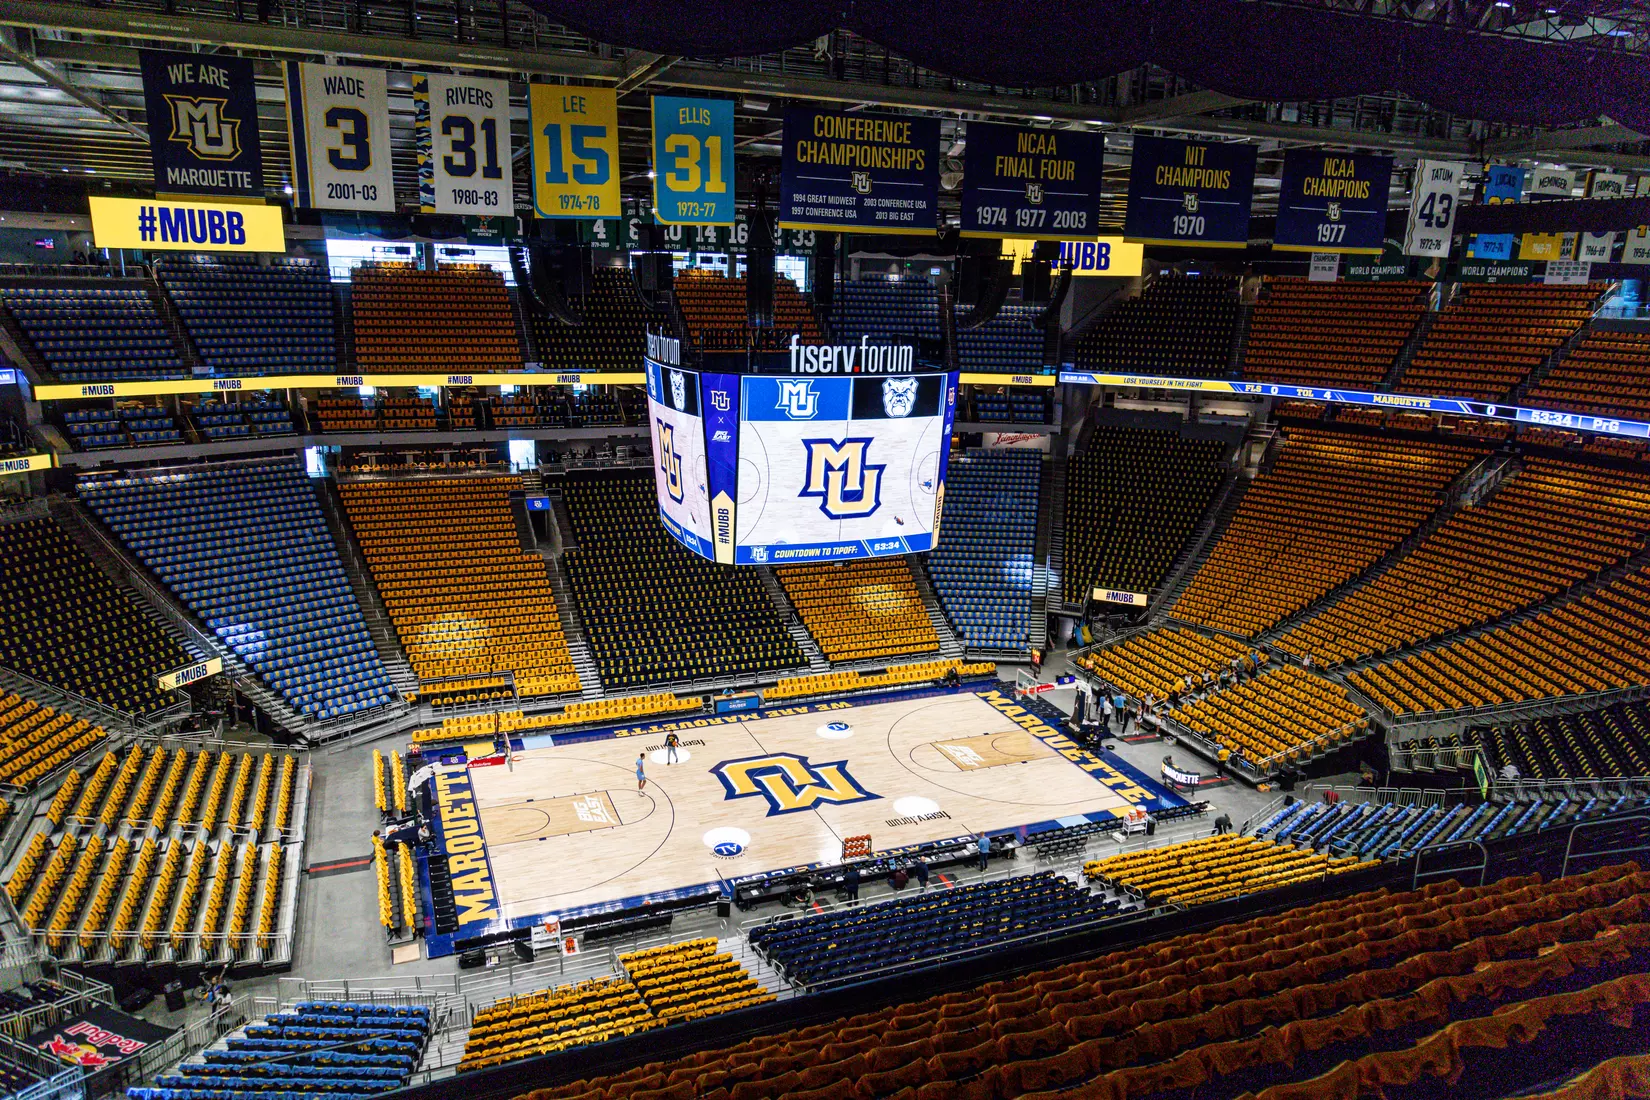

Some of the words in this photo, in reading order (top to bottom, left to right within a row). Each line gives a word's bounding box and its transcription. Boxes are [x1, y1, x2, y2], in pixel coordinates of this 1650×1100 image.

[168, 63, 195, 85] WE
[198, 65, 230, 90] ARE
[324, 76, 365, 99] WADE
[446, 87, 493, 109] RIVERS
[563, 96, 586, 115] LEE
[679, 107, 711, 126] ELLIS
[163, 94, 241, 161] MU
[814, 115, 912, 144] CONFERENCE
[324, 106, 372, 172] 3
[441, 114, 503, 180] 31
[1017, 132, 1057, 156] NCAA
[543, 123, 610, 185] 15
[665, 134, 726, 193] 31
[797, 140, 925, 171] CHAMPIONSHIPS
[1185, 146, 1207, 166] NIT
[167, 167, 252, 189] MARQUETTE
[995, 156, 1036, 178] FINAL
[1040, 159, 1075, 181] FOUR
[1156, 166, 1231, 189] CHAMPIONS
[1323, 158, 1355, 178] NCAA
[1432, 168, 1453, 184] TATUM
[851, 171, 872, 194] MU
[1303, 177, 1370, 199] CHAMPIONS
[1495, 174, 1516, 188] LUCAS
[1595, 180, 1622, 194] THOMPSON
[327, 182, 377, 201] 2001-03
[452, 188, 498, 206] 1980-83
[793, 193, 806, 202] 1994
[807, 194, 826, 204] GREAT
[828, 196, 856, 206] MIDWEST
[1025, 183, 1044, 204] MU
[559, 194, 600, 210] 1974-78
[677, 201, 716, 218] 1973-77
[864, 198, 876, 206] 2003
[878, 198, 914, 208] CONFERENCE
[915, 200, 927, 209] USA
[1183, 192, 1198, 213] MU
[1326, 202, 1342, 222] MU
[1418, 192, 1453, 229] 43
[792, 206, 804, 216] 1997
[805, 207, 844, 218] CONFERENCE
[844, 210, 857, 219] USA
[876, 212, 888, 220] 2013
[889, 212, 899, 220] BIG
[900, 212, 915, 221] EAST
[976, 206, 1007, 226] 1974
[1016, 208, 1046, 228] 1977
[1053, 210, 1087, 228] 2003
[138, 206, 246, 245] #MUBB
[593, 219, 606, 239] 4
[728, 224, 748, 244] 16
[1172, 215, 1205, 236] 1970
[1317, 223, 1346, 243] 1977
[1420, 238, 1442, 250] 1972-76
[1350, 266, 1370, 275] WORLD
[1370, 266, 1405, 275] CHAMPIONS
[1462, 266, 1485, 276] WORLD
[1486, 266, 1529, 276] CHAMPIONS
[213, 379, 242, 390] #MUBB
[336, 376, 364, 386] #MUBB
[448, 375, 473, 385] #MUBB
[556, 374, 581, 384] #MUBB
[1012, 376, 1032, 384] #MUBB
[82, 385, 115, 396] #MUBB
[774, 379, 820, 420] MU
[1245, 384, 1262, 393] FLS
[1270, 386, 1278, 395] 0
[1296, 388, 1314, 397] TOL
[1324, 390, 1332, 400] 4
[711, 390, 730, 412] MU
[1373, 394, 1431, 408] MARQUETTE
[1486, 404, 1496, 416] 0
[1530, 411, 1572, 426] 53:34
[1592, 419, 1620, 432] PrG
[0, 459, 30, 472] #MUBB
[656, 418, 685, 505] MU
[797, 436, 888, 520] MU
[718, 508, 730, 544] #MUBB
[774, 549, 820, 559] COUNTDOWN
[822, 548, 832, 556] TO
[832, 546, 858, 555] TIPOFF:
[1105, 590, 1134, 604] #MUBB
[175, 664, 208, 685] #MUBB
[762, 704, 809, 719] ARE
[818, 701, 853, 712] WE
[614, 710, 761, 738] MARQUETTE
[976, 690, 1157, 804] MARQUETTE
[708, 752, 884, 818] MU
[434, 767, 500, 925] MARQUETT
